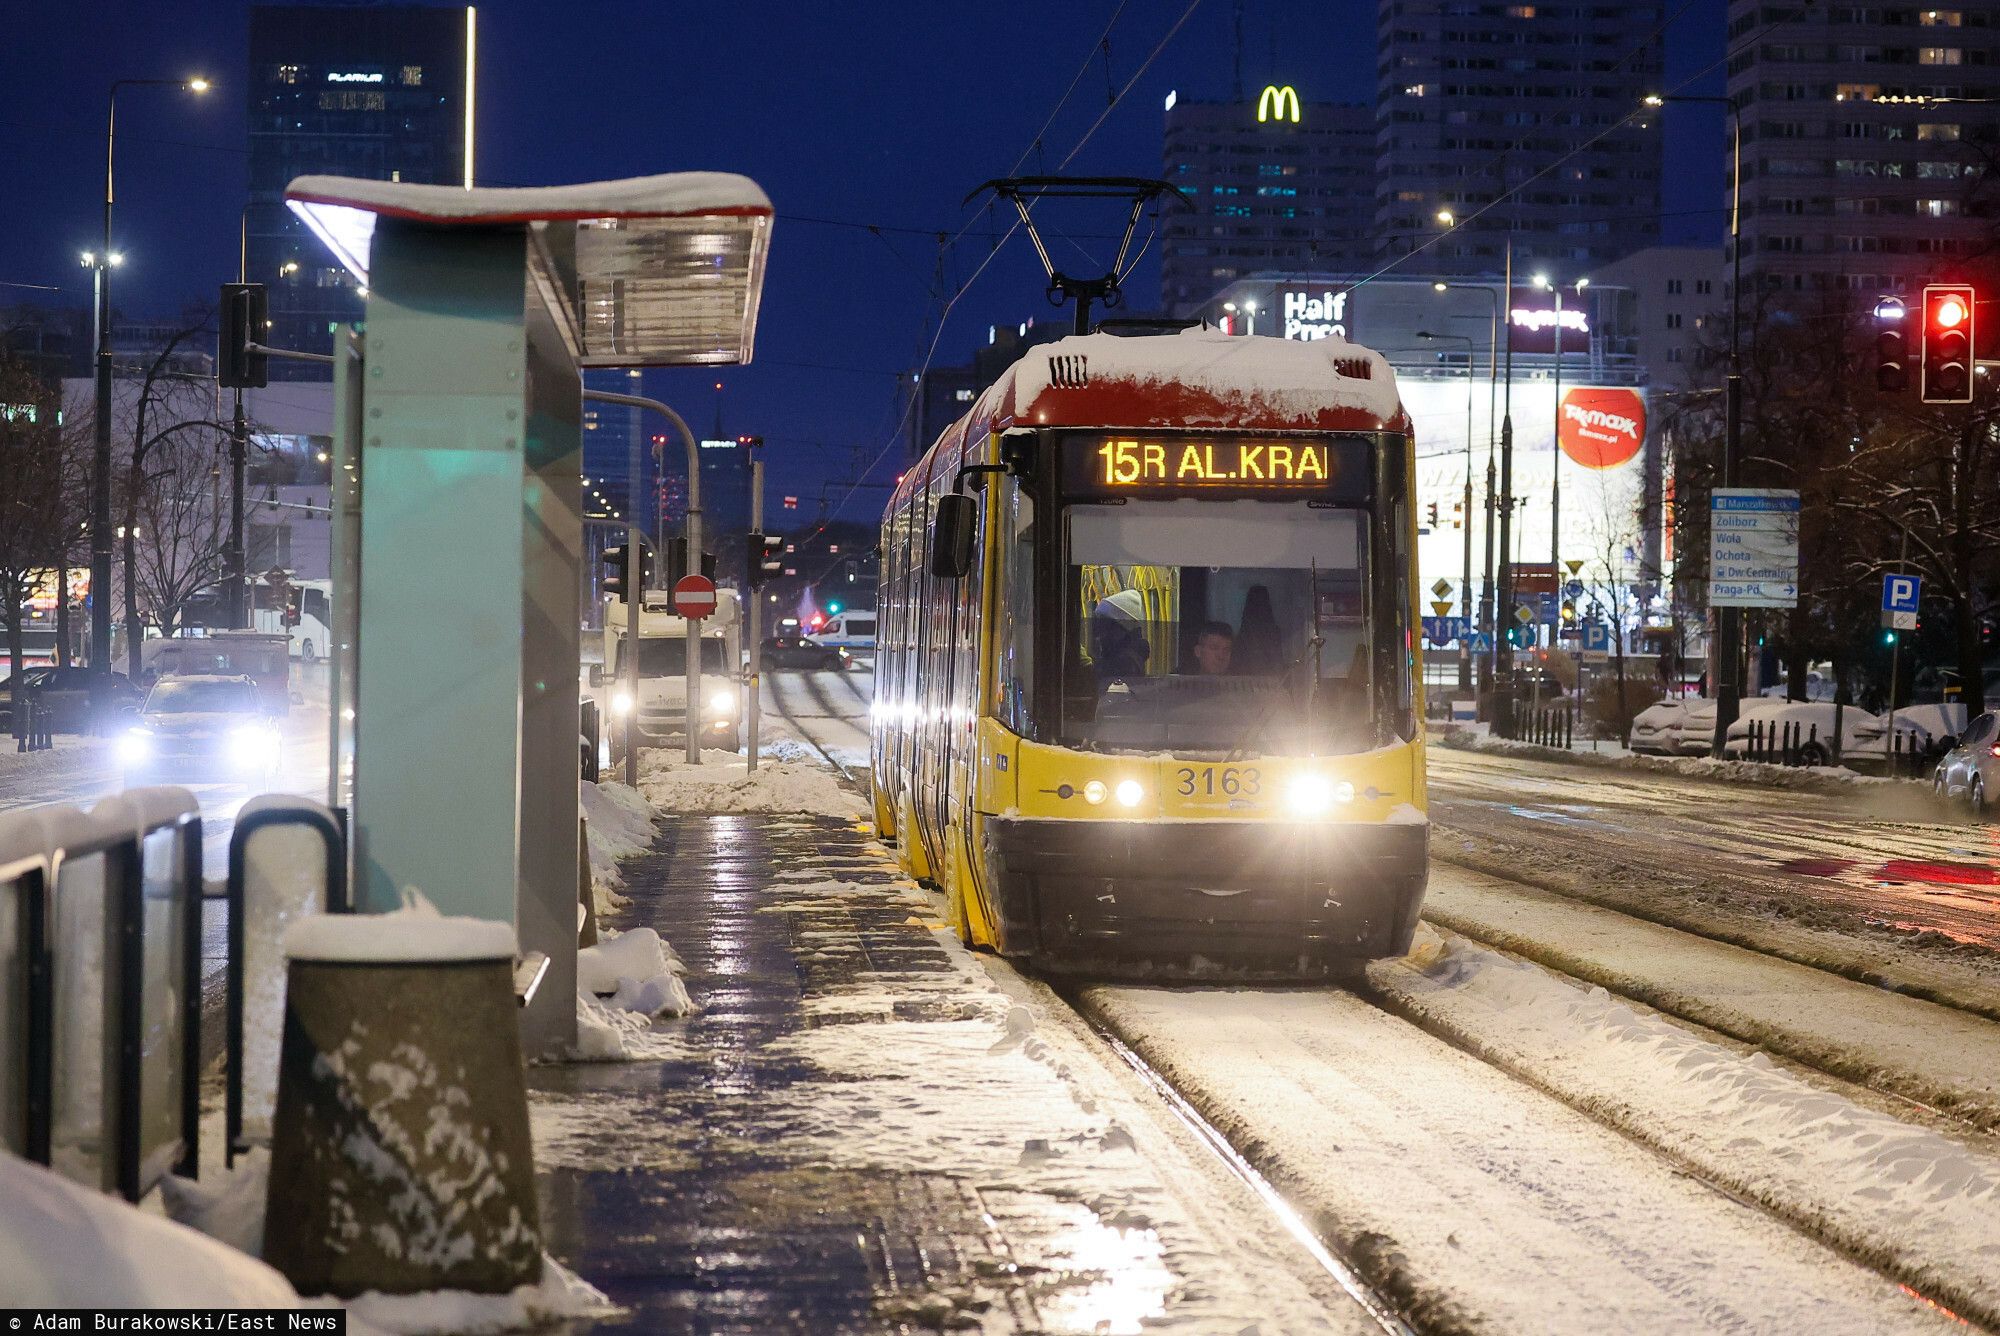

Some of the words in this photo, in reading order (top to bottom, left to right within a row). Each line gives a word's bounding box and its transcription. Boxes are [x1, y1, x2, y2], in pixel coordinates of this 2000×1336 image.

[1285, 292, 1347, 320] Half
[1177, 445, 1328, 480] AL.KRA
[1716, 533, 1742, 544] Wola
[1715, 550, 1751, 561] Ochota
[1746, 567, 1792, 581] Centralny
[1891, 579, 1913, 607] P
[1588, 627, 1604, 647] P
[1177, 767, 1262, 796] 3163
